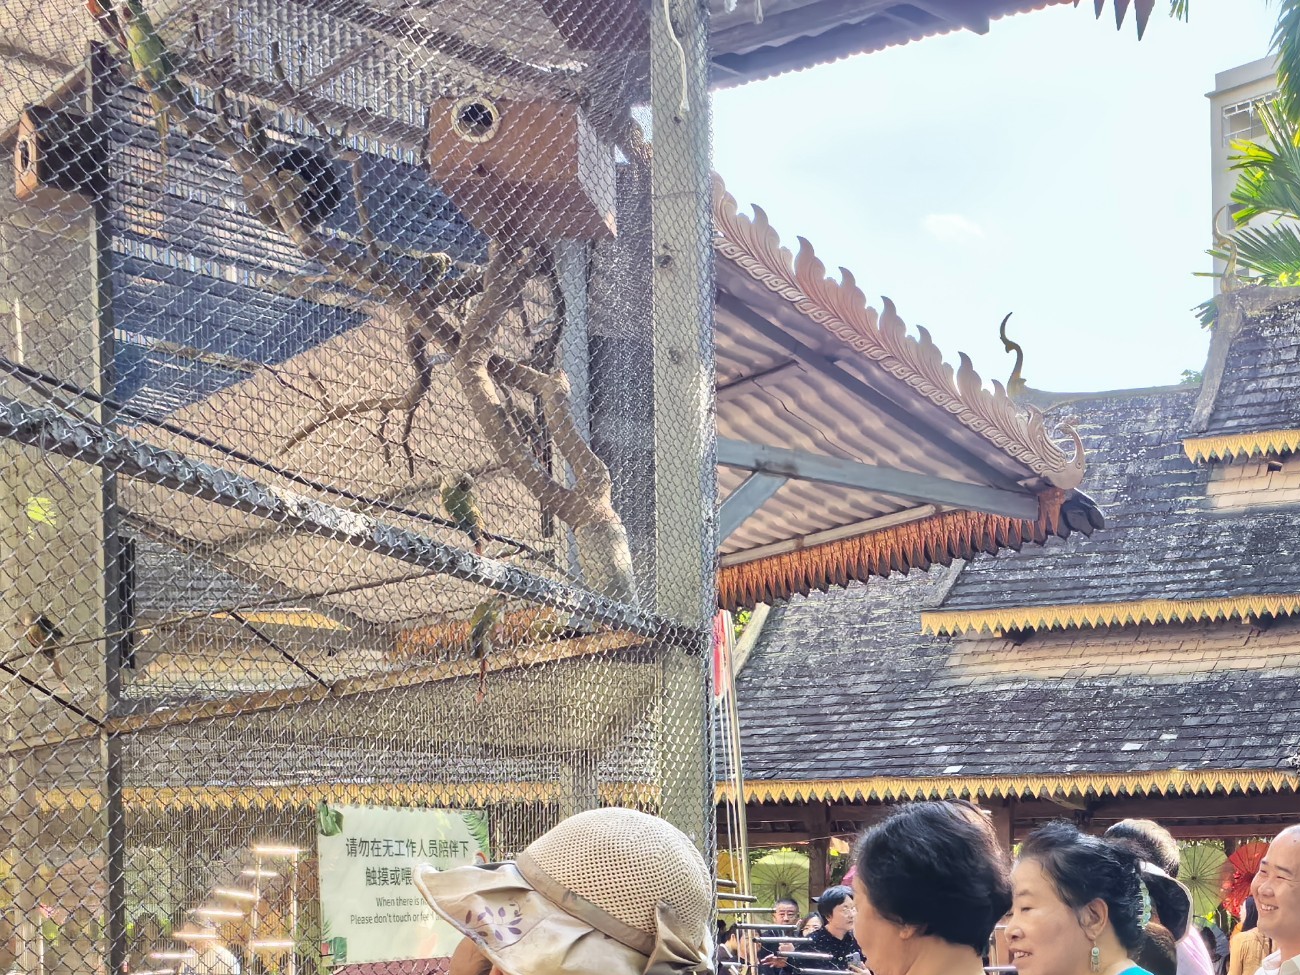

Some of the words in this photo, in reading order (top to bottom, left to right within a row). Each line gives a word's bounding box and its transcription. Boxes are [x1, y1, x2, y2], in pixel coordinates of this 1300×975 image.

[346, 838, 469, 858] 请勿在无工作人员陪伴下
[366, 866, 449, 886] 触摸或喂
[376, 896, 396, 906] When
[396, 896, 414, 906] there
[414, 896, 420, 906] is
[350, 914, 373, 925] Please
[374, 912, 392, 924] don't
[393, 911, 412, 923] touch
[412, 914, 420, 922] or
